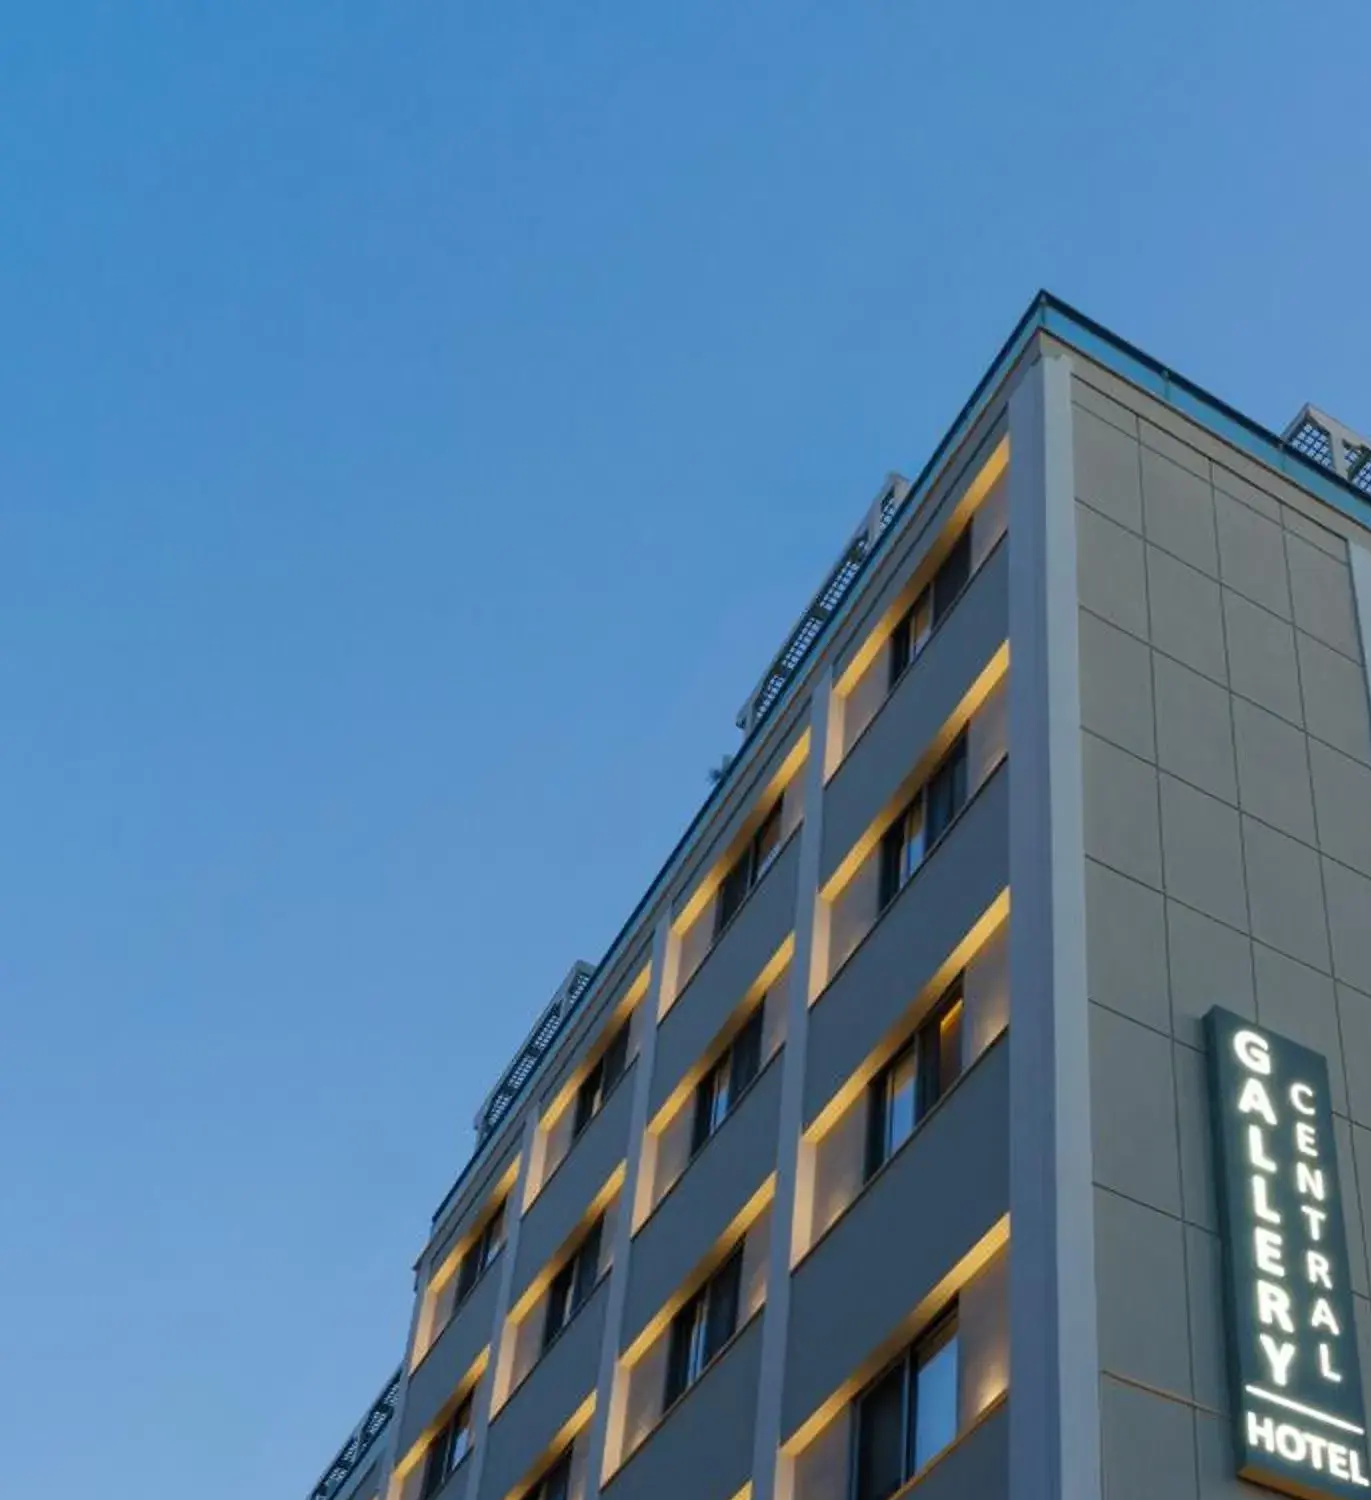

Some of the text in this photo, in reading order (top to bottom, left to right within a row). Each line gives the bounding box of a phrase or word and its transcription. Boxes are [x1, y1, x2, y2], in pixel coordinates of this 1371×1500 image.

[1232, 1029, 1295, 1388] GALLERY
[1289, 1082, 1342, 1383] CENTRAL
[1247, 1411, 1370, 1487] HOTEL
